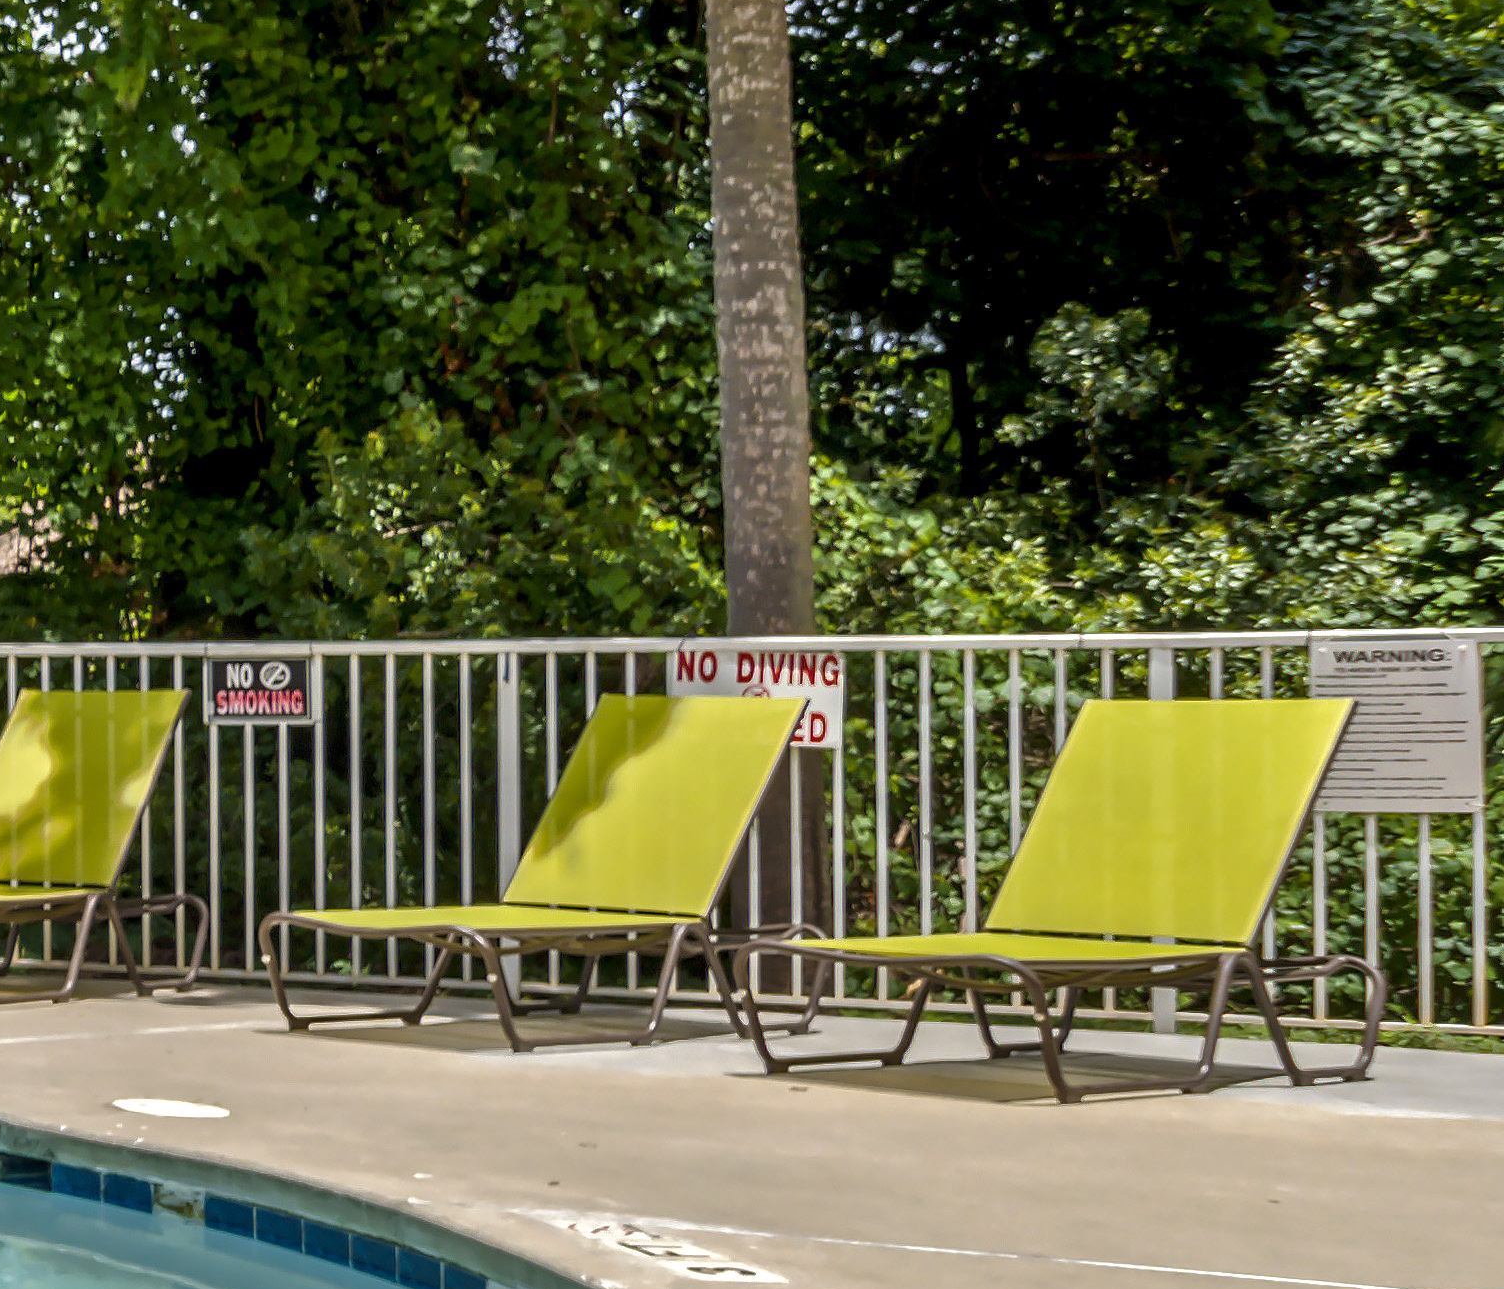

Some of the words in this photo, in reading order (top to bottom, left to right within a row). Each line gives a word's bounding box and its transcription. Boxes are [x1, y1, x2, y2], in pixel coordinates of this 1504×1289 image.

[226, 662, 253, 688] NO
[677, 650, 717, 682] NO
[736, 652, 839, 686] DIVING
[216, 689, 303, 715] SMOKING
